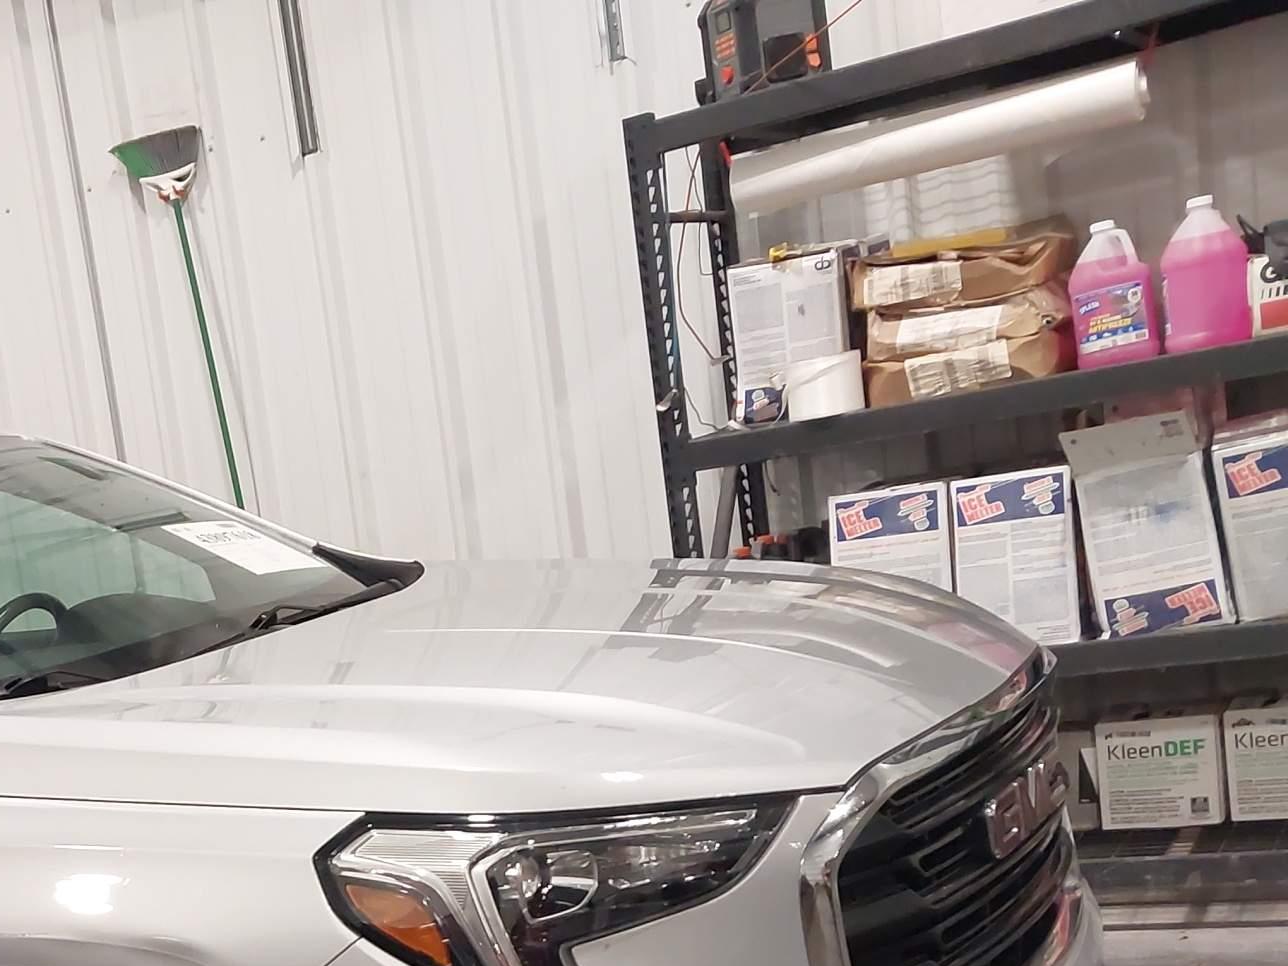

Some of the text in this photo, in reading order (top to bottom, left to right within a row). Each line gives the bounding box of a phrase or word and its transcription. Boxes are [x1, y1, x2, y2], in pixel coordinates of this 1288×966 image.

[1229, 463, 1256, 483] ICE
[961, 495, 987, 514] ICE
[966, 503, 1003, 522] MELTER
[840, 509, 865, 530] ICE
[1107, 738, 1207, 761] KleenDEF
[985, 759, 1069, 860] GMC
